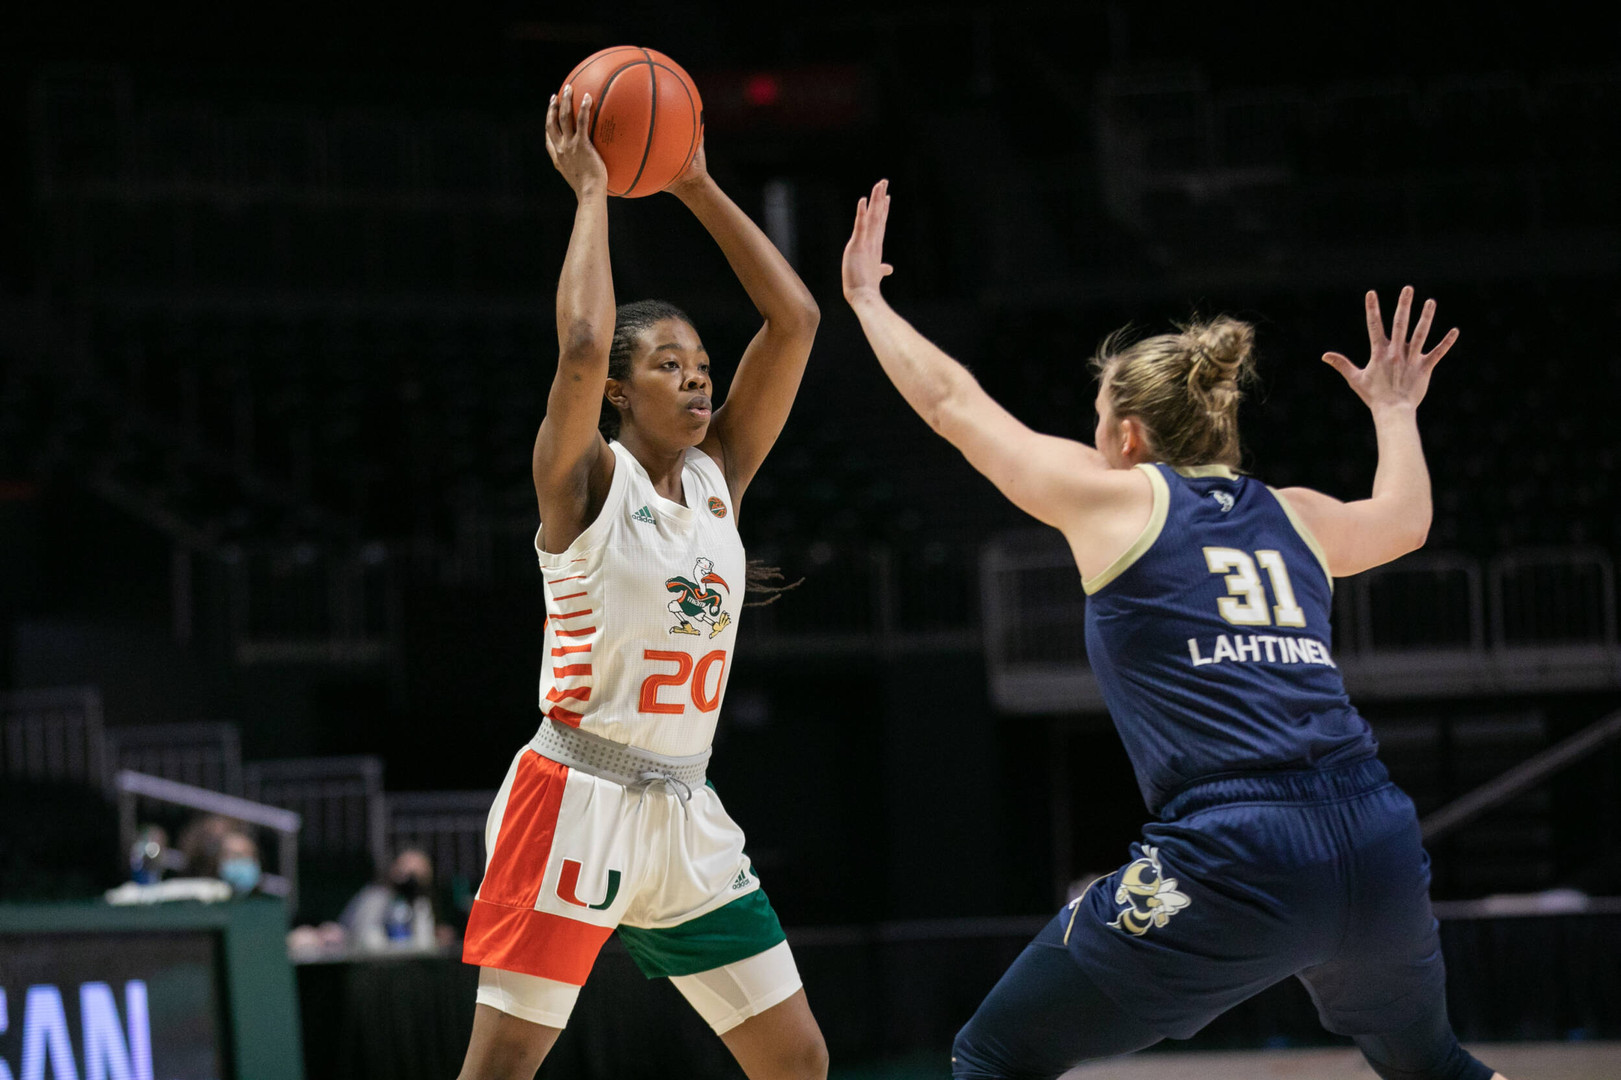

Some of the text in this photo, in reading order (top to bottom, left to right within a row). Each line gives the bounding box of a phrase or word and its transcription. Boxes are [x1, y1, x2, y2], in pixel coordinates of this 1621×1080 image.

[1202, 546, 1307, 627] 31
[638, 649, 727, 714] 20
[555, 858, 622, 910] U
[0, 979, 154, 1080] AN
